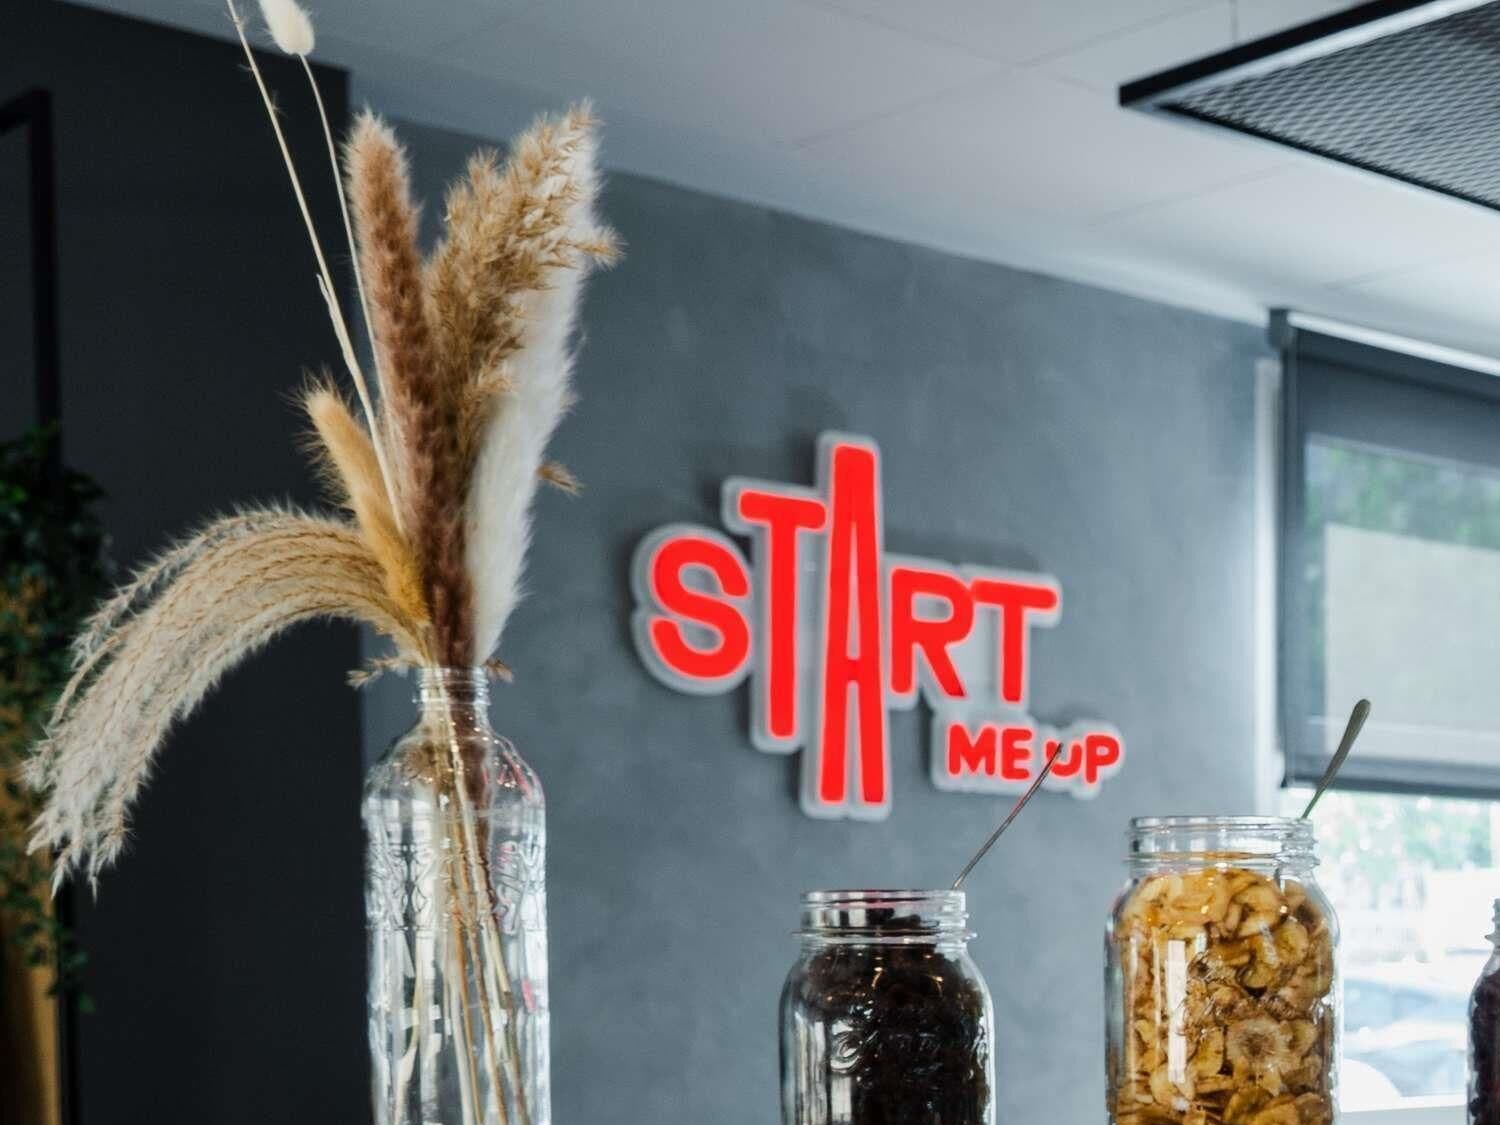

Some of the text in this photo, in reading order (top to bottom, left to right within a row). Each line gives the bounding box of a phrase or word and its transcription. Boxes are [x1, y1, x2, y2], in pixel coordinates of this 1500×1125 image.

[650, 444, 1059, 803] START
[947, 724, 1121, 784] ME UP
